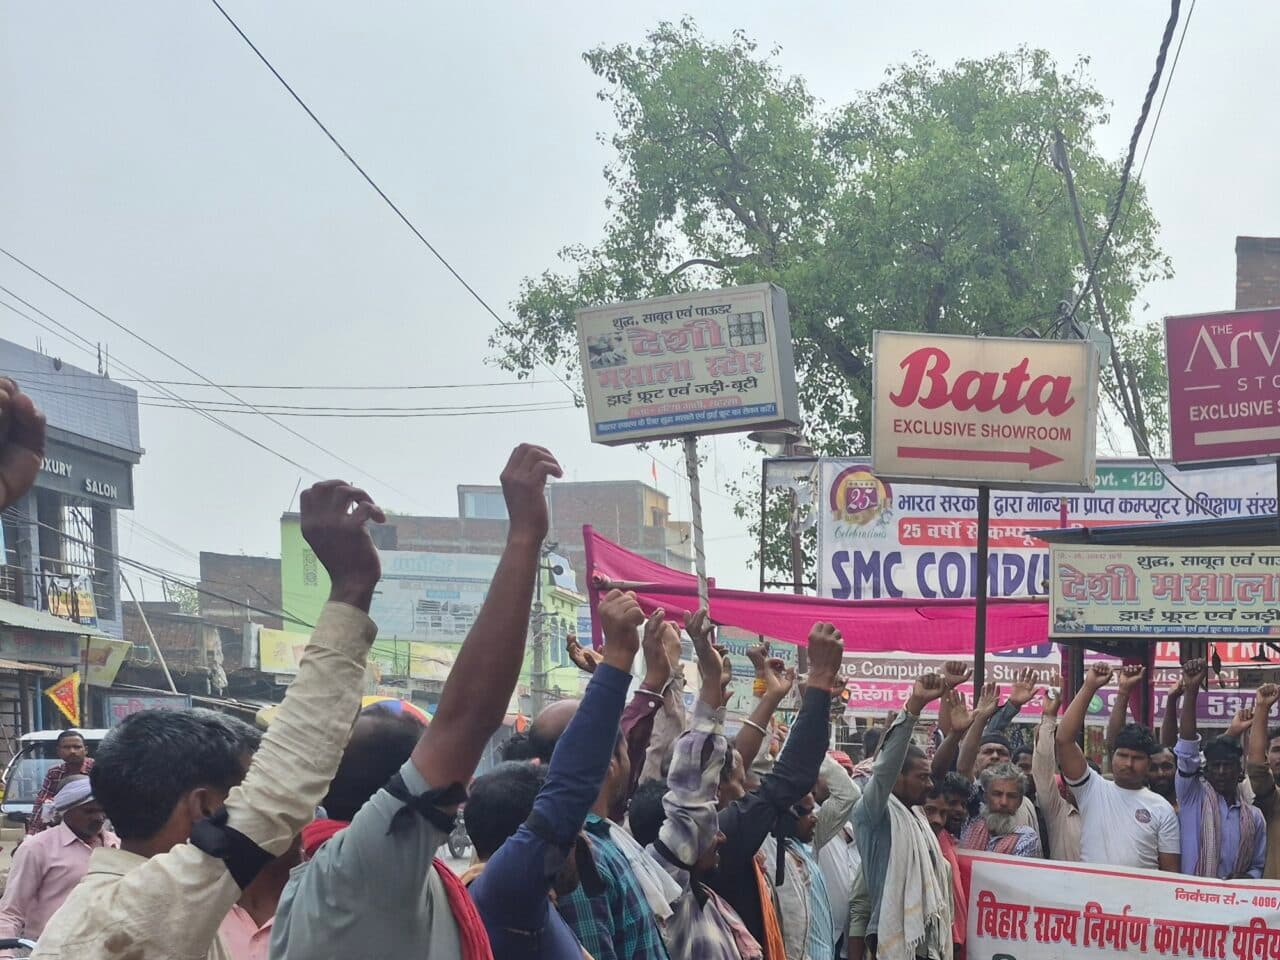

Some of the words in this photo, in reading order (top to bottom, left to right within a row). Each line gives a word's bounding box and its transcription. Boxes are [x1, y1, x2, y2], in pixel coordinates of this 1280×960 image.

[676, 305, 693, 320] एवं
[627, 318, 725, 356] देशी
[1211, 324, 1233, 335] THE
[598, 359, 694, 389] मसाला
[705, 348, 766, 378] स्टोर
[889, 347, 1075, 417] Bata
[606, 391, 632, 408] ड्राई
[668, 383, 690, 397] एवं
[1190, 399, 1273, 421] EXCLUSIVE
[893, 419, 976, 437] EXCLUSIVE
[981, 424, 1071, 441] SHOWROOM
[85, 478, 118, 499] SALON
[1094, 472, 1118, 487] ovt.
[1131, 470, 1163, 487] 1218
[847, 488, 871, 510] 25
[898, 494, 936, 513] भारत
[939, 495, 980, 513] सरका
[994, 496, 1023, 516] द्वारा
[1083, 497, 1115, 516] प्राप्त
[903, 523, 921, 539] 25
[1137, 555, 1174, 569] शुद्ध,
[1181, 555, 1225, 571] साबूत
[1230, 552, 1255, 566] एवं
[831, 550, 904, 600] SMC
[917, 551, 1050, 600] COMPU
[1058, 563, 1140, 605] देशी
[1119, 608, 1155, 622] ड्राई
[1161, 610, 1199, 624] फ्रूट
[1204, 608, 1237, 621] एवं
[841, 662, 857, 675] ne
[1175, 888, 1220, 904] निबंधन
[977, 890, 1030, 941] बिहार
[1034, 906, 1081, 946] राज्य
[1083, 901, 1150, 952] निर्माण
[1154, 918, 1229, 960] कामगार
